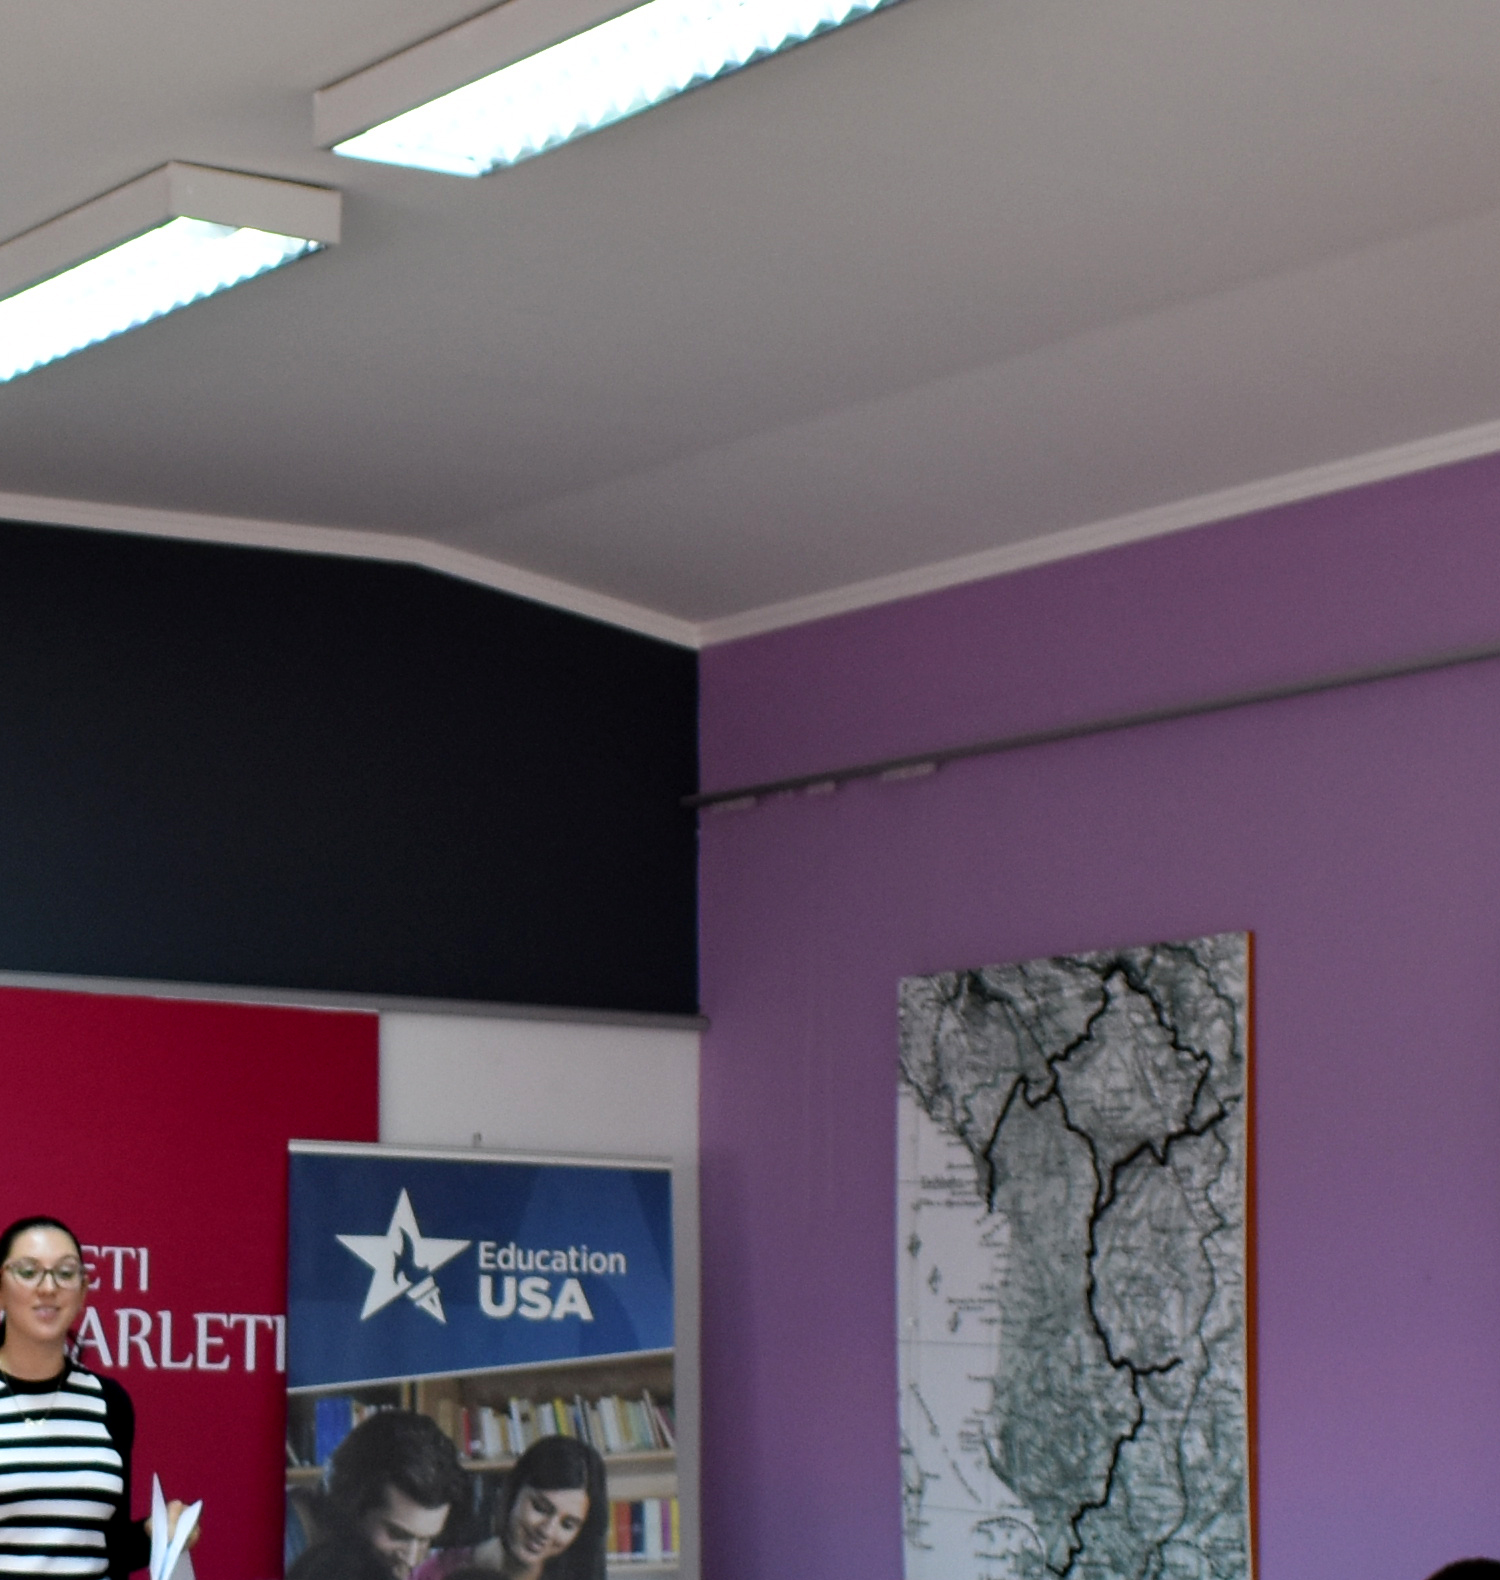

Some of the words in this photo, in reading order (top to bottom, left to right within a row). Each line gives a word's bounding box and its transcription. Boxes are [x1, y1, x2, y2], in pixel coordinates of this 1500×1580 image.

[478, 1239, 627, 1275] Education
[478, 1275, 595, 1323] USA
[64, 1306, 287, 1374] ARLETI
